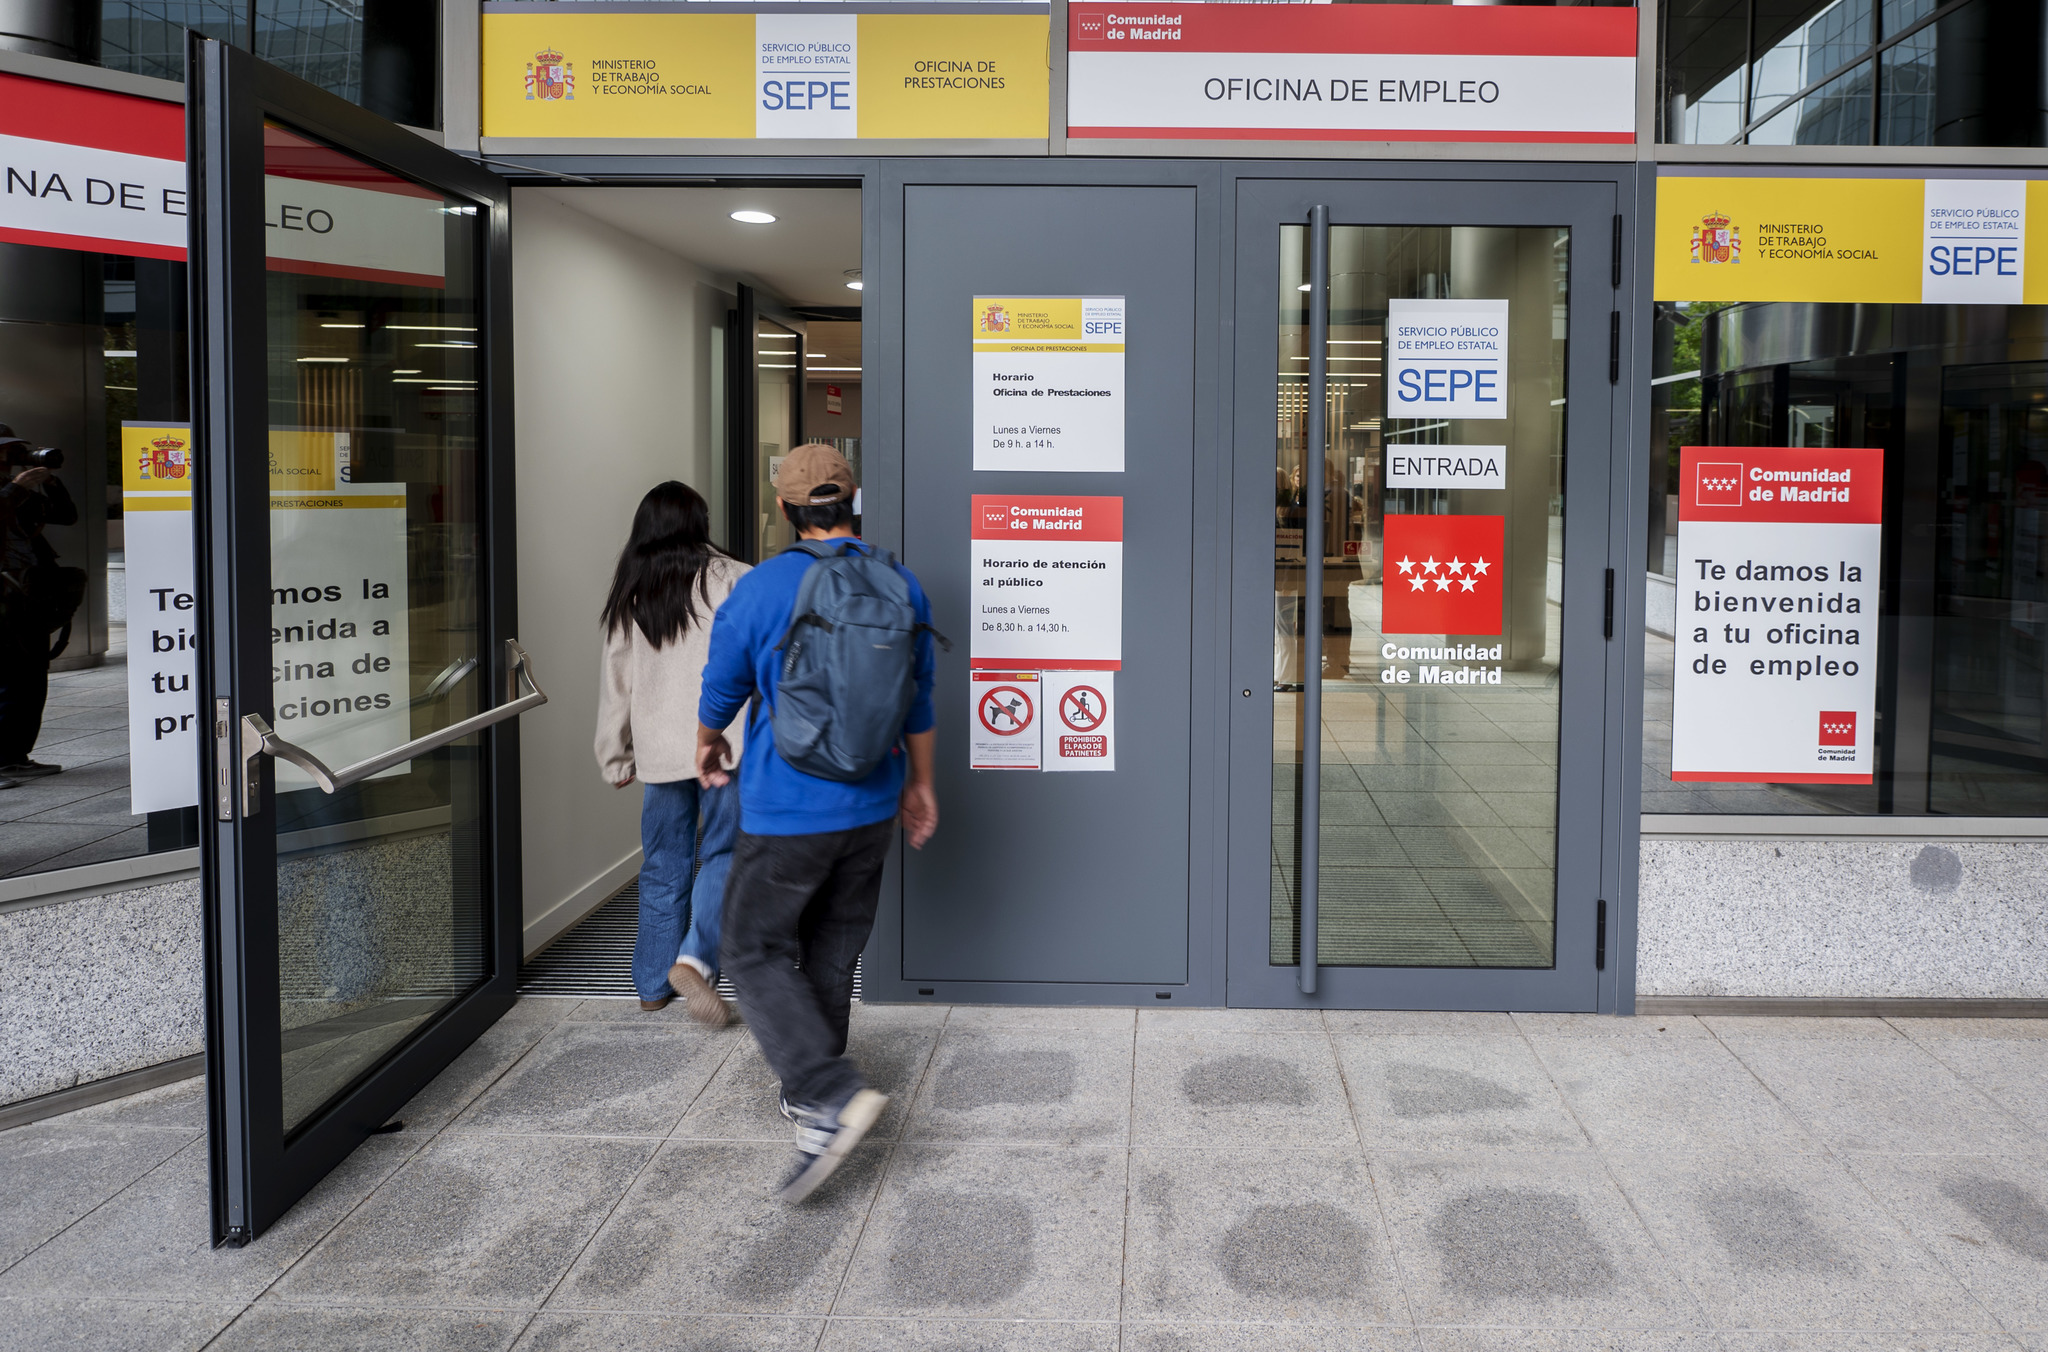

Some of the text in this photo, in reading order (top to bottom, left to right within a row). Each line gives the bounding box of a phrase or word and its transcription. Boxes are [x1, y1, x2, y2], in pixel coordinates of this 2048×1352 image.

[1107, 14, 1182, 26] Comunidad
[1107, 28, 1182, 40] de Madrid
[762, 42, 851, 52] SERVICIO PÚBLICO
[592, 60, 656, 70] MINISTERIO
[762, 56, 851, 64] DE EMPLEO ESTATAL
[914, 60, 996, 72] OFICINA DE
[592, 72, 660, 84] DE TRABAJO
[904, 77, 1005, 88] PRESTACIONES
[592, 83, 712, 94] Y ECONOMÍA SOCIAL
[1204, 78, 1500, 104] OFICINA DE EMPLEO
[762, 80, 851, 110] SEPE
[86, 178, 146, 211] DE
[1930, 208, 2020, 218] SERVICIO PÚBLICO
[1760, 224, 1824, 234] MINISTERIO
[1930, 221, 2018, 230] DE EMPLEO ESTATAL
[1759, 236, 1827, 248] DE TRABAJO
[1759, 248, 1879, 260] Y ECONOMÍA SOCIAL
[1930, 246, 2018, 276] SEPE
[1085, 322, 1122, 334] SEPE
[1398, 325, 1498, 336] SERVICIO PÚBLICO
[1398, 341, 1498, 350] DE EMPLEO ESTATAL
[993, 373, 1034, 382] Horario
[1398, 368, 1498, 402] SEPE
[993, 388, 1112, 397] Oficina de Prestaciones
[993, 426, 1018, 434] Lunes
[1028, 426, 1061, 434] Viernes
[993, 440, 1005, 448] De
[1008, 440, 1013, 448] 9
[1016, 440, 1024, 448] h.
[1034, 440, 1044, 448] 14
[1046, 440, 1054, 448] h.
[1392, 458, 1498, 476] ENTRADA
[1750, 468, 1850, 482] Comunidad
[1749, 487, 1850, 502] de Madrid
[1010, 506, 1083, 516] Comunidad
[1010, 519, 1082, 530] de Madrid
[983, 558, 1106, 569] Horario de atención
[1695, 559, 1862, 582] Te damos la
[983, 578, 1044, 588] al público
[150, 588, 194, 612] Te
[363, 578, 389, 600] la
[1694, 591, 1861, 614] bienvenida
[982, 605, 1008, 614] Lunes
[1018, 605, 1050, 614] Viernes
[372, 620, 390, 636] a
[982, 622, 994, 631] De
[996, 622, 1015, 632] 8,30
[1018, 623, 1026, 632] h.
[1036, 624, 1059, 633] 14,30
[1062, 624, 1070, 632] h.
[1693, 624, 1860, 645] a tu oficina
[1382, 642, 1502, 660] Comunidad
[1692, 654, 1859, 680] de empleo
[152, 672, 189, 694] tu
[352, 653, 391, 676] de
[1381, 666, 1502, 684] de Madrid
